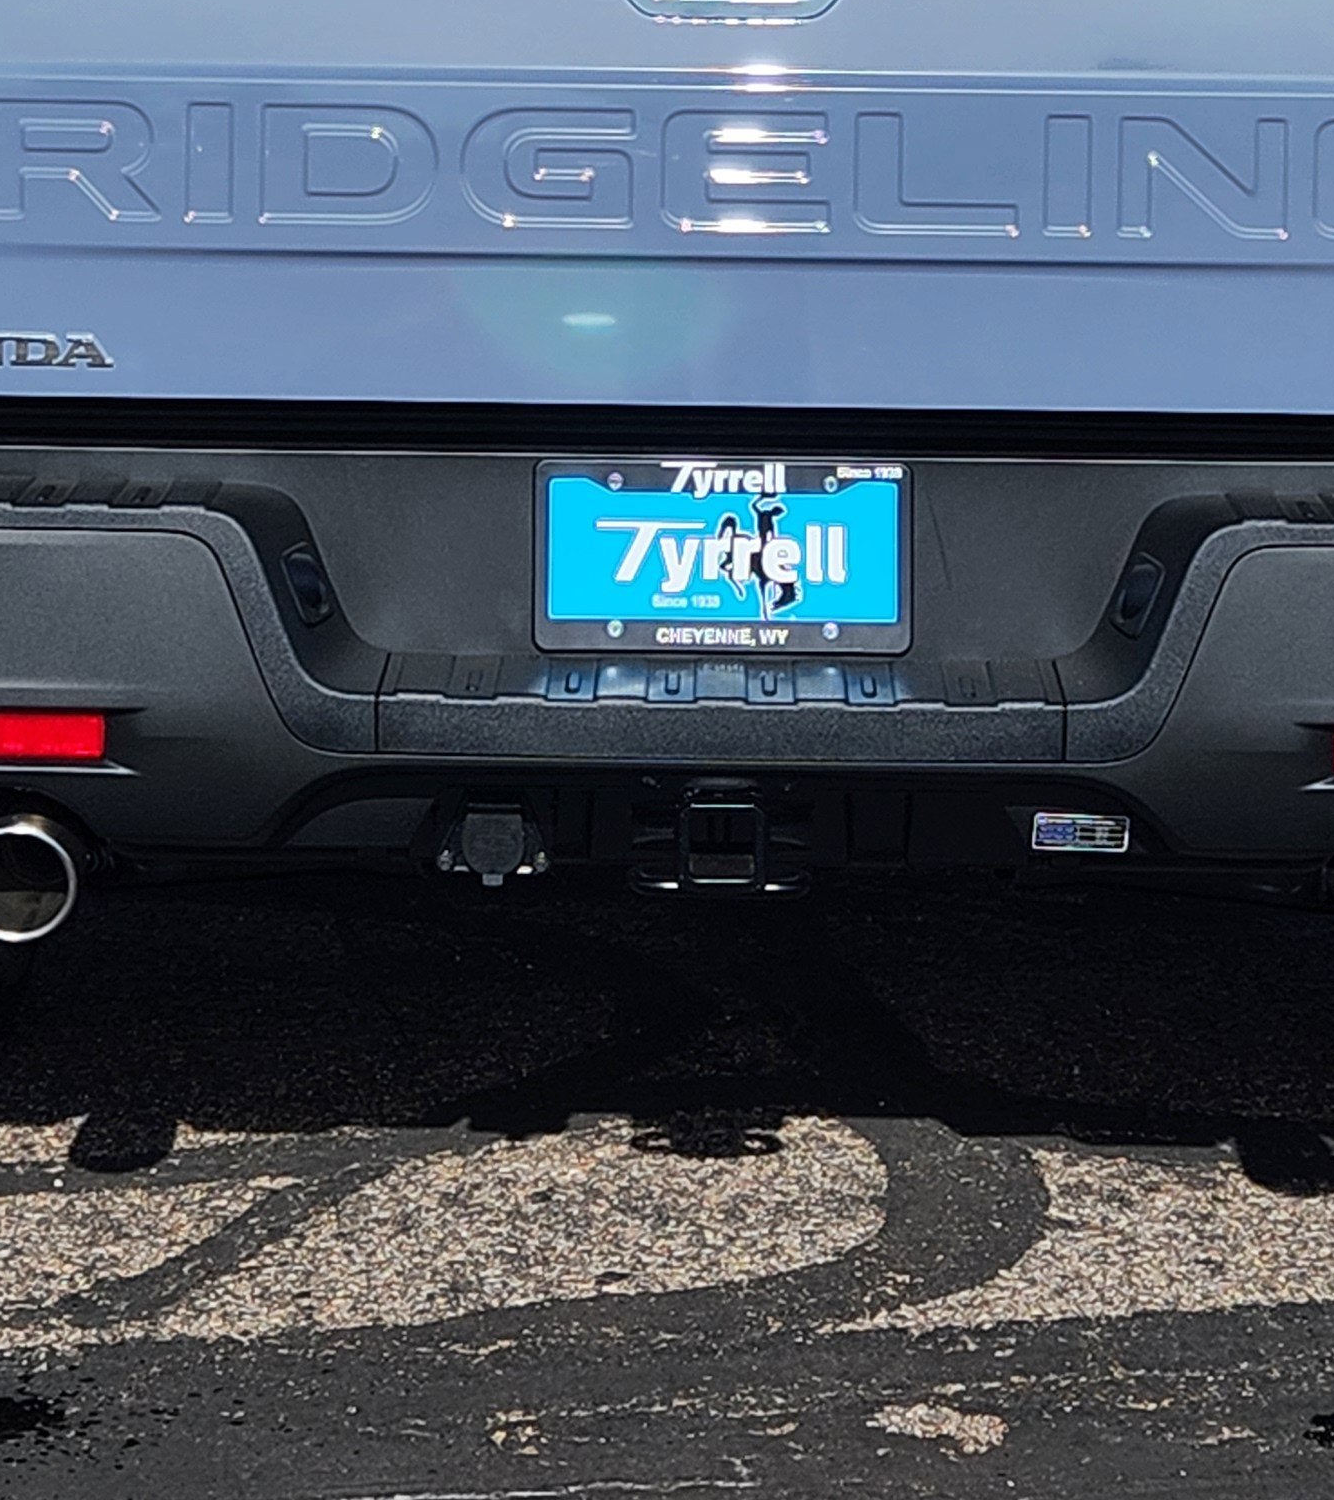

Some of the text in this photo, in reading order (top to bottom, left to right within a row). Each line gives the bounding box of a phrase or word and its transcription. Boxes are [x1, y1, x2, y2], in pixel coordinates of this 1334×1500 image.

[660, 461, 787, 499] Tyrrell
[595, 519, 848, 592] Tyrrell
[655, 627, 789, 647] CHEYENNE, WY
